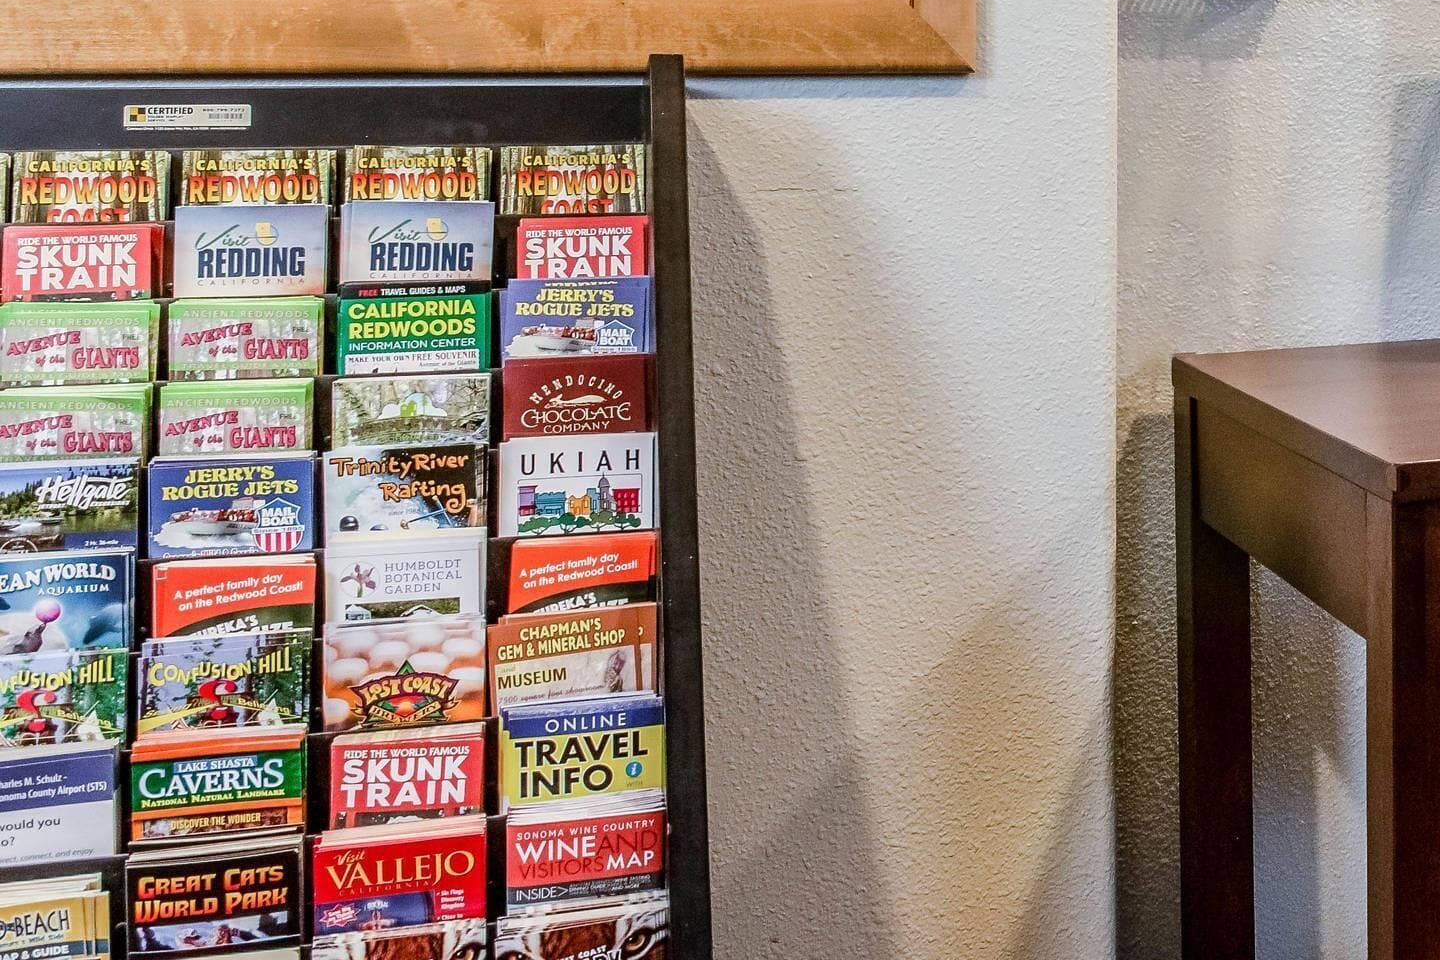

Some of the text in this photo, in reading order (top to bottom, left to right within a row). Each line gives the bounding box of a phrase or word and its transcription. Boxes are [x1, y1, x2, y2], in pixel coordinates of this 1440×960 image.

[147, 107, 194, 115] CERTIFIED
[28, 160, 151, 173] CALIFORNIA'S
[196, 159, 314, 171] CALIFORNIA'S
[358, 156, 471, 169] CALIFORNIA'S
[523, 154, 631, 167] CALIFORNIA'S
[20, 176, 156, 205] REDWOOD
[188, 174, 320, 202] REDWOOD
[351, 171, 476, 200] REDWOOD
[516, 168, 636, 196] REDWOOD
[18, 234, 138, 246] RIDE THE WORLD FAMOUS
[525, 227, 633, 238] RIDE THE WORLD FAMOUS
[16, 243, 137, 268] SKUNK
[370, 242, 474, 271] REDDING
[525, 235, 632, 259] SKUNK
[197, 247, 306, 278] REDDING
[524, 256, 632, 279] TRAIN
[15, 264, 136, 291] TRAIN
[380, 285, 466, 296] TRAVEL GUIDES MAPS
[536, 288, 615, 303] JERRY'S
[240, 309, 309, 318] REDWOODS
[348, 300, 476, 319] CALIFORNIA
[515, 302, 634, 317] ROGUE JETS
[181, 322, 253, 346] AVENUE
[348, 318, 476, 339] REDWOODS
[600, 328, 630, 337] MAIL
[6, 330, 81, 356] AVENUE
[243, 337, 309, 360] GIANTS
[349, 338, 476, 352] INFORMATION CENTER
[600, 336, 631, 346] BOAT
[71, 346, 140, 369] GIANTS
[435, 350, 477, 360] SOUVENIR
[529, 374, 623, 404] MENDOCINO
[167, 397, 297, 407] ANCIENT REDWOODS
[0, 414, 73, 439] AVENUE
[165, 410, 239, 436] AVENUE
[521, 402, 631, 428] CHOCOLATE
[229, 425, 297, 448] GIANTS
[543, 420, 610, 434] COMPANY
[63, 431, 133, 453] GIANTS
[329, 452, 469, 481] Trinity River
[521, 448, 640, 476] UKIAH
[184, 465, 275, 484] JERRY'S
[35, 475, 134, 509] Hellgate
[161, 479, 299, 501] ROGUE JETS
[378, 480, 466, 514] Rafting
[261, 507, 295, 517] MAIL
[261, 516, 296, 526] BOAT
[44, 562, 117, 581] WORLD
[384, 558, 463, 572] HUMBOLDT
[529, 552, 620, 577] perfect family day
[185, 574, 283, 598] perfect family day
[384, 570, 463, 584] BOTANICAL
[384, 582, 441, 595] GARDEN
[523, 567, 604, 589] on the Redwood
[37, 584, 110, 595] AQUARIUM
[178, 589, 267, 612] on the Redwood
[519, 617, 602, 641] CHAPMAN'S
[497, 628, 625, 661] GEM MINERAL SHOP
[79, 655, 115, 684] HILL
[149, 646, 293, 687] CONFUSION HILL
[359, 676, 453, 704] LOST COAST
[497, 667, 567, 690] MUSEUM
[544, 712, 627, 733] ONLINE
[344, 745, 470, 759] RIDE THE WORLD FAMOUS
[514, 730, 648, 768] TRAVEL
[178, 757, 255, 773] LAKE SHASTA
[342, 755, 467, 784] SKUNK
[28, 781, 107, 798] County Airport (STS)
[138, 758, 285, 799] CAVERNS
[520, 763, 613, 798] INFO
[141, 789, 285, 808] NATIONAL NATURAL LANDMARK
[340, 779, 466, 808] TRAIN
[38, 818, 61, 830] you
[171, 812, 261, 830] DISCOVER WONDER
[516, 818, 655, 841] SONOMA WINE COUNTRY
[334, 848, 366, 866] Visit
[515, 830, 658, 864] WINE AND
[325, 850, 475, 890] VALLEJO
[518, 850, 655, 880] VISITORS MAP
[138, 865, 284, 900] GREAT CATS
[134, 887, 288, 923] WORLD PARK
[15, 909, 70, 937] BEACH
[32, 944, 70, 958] GUIDE
